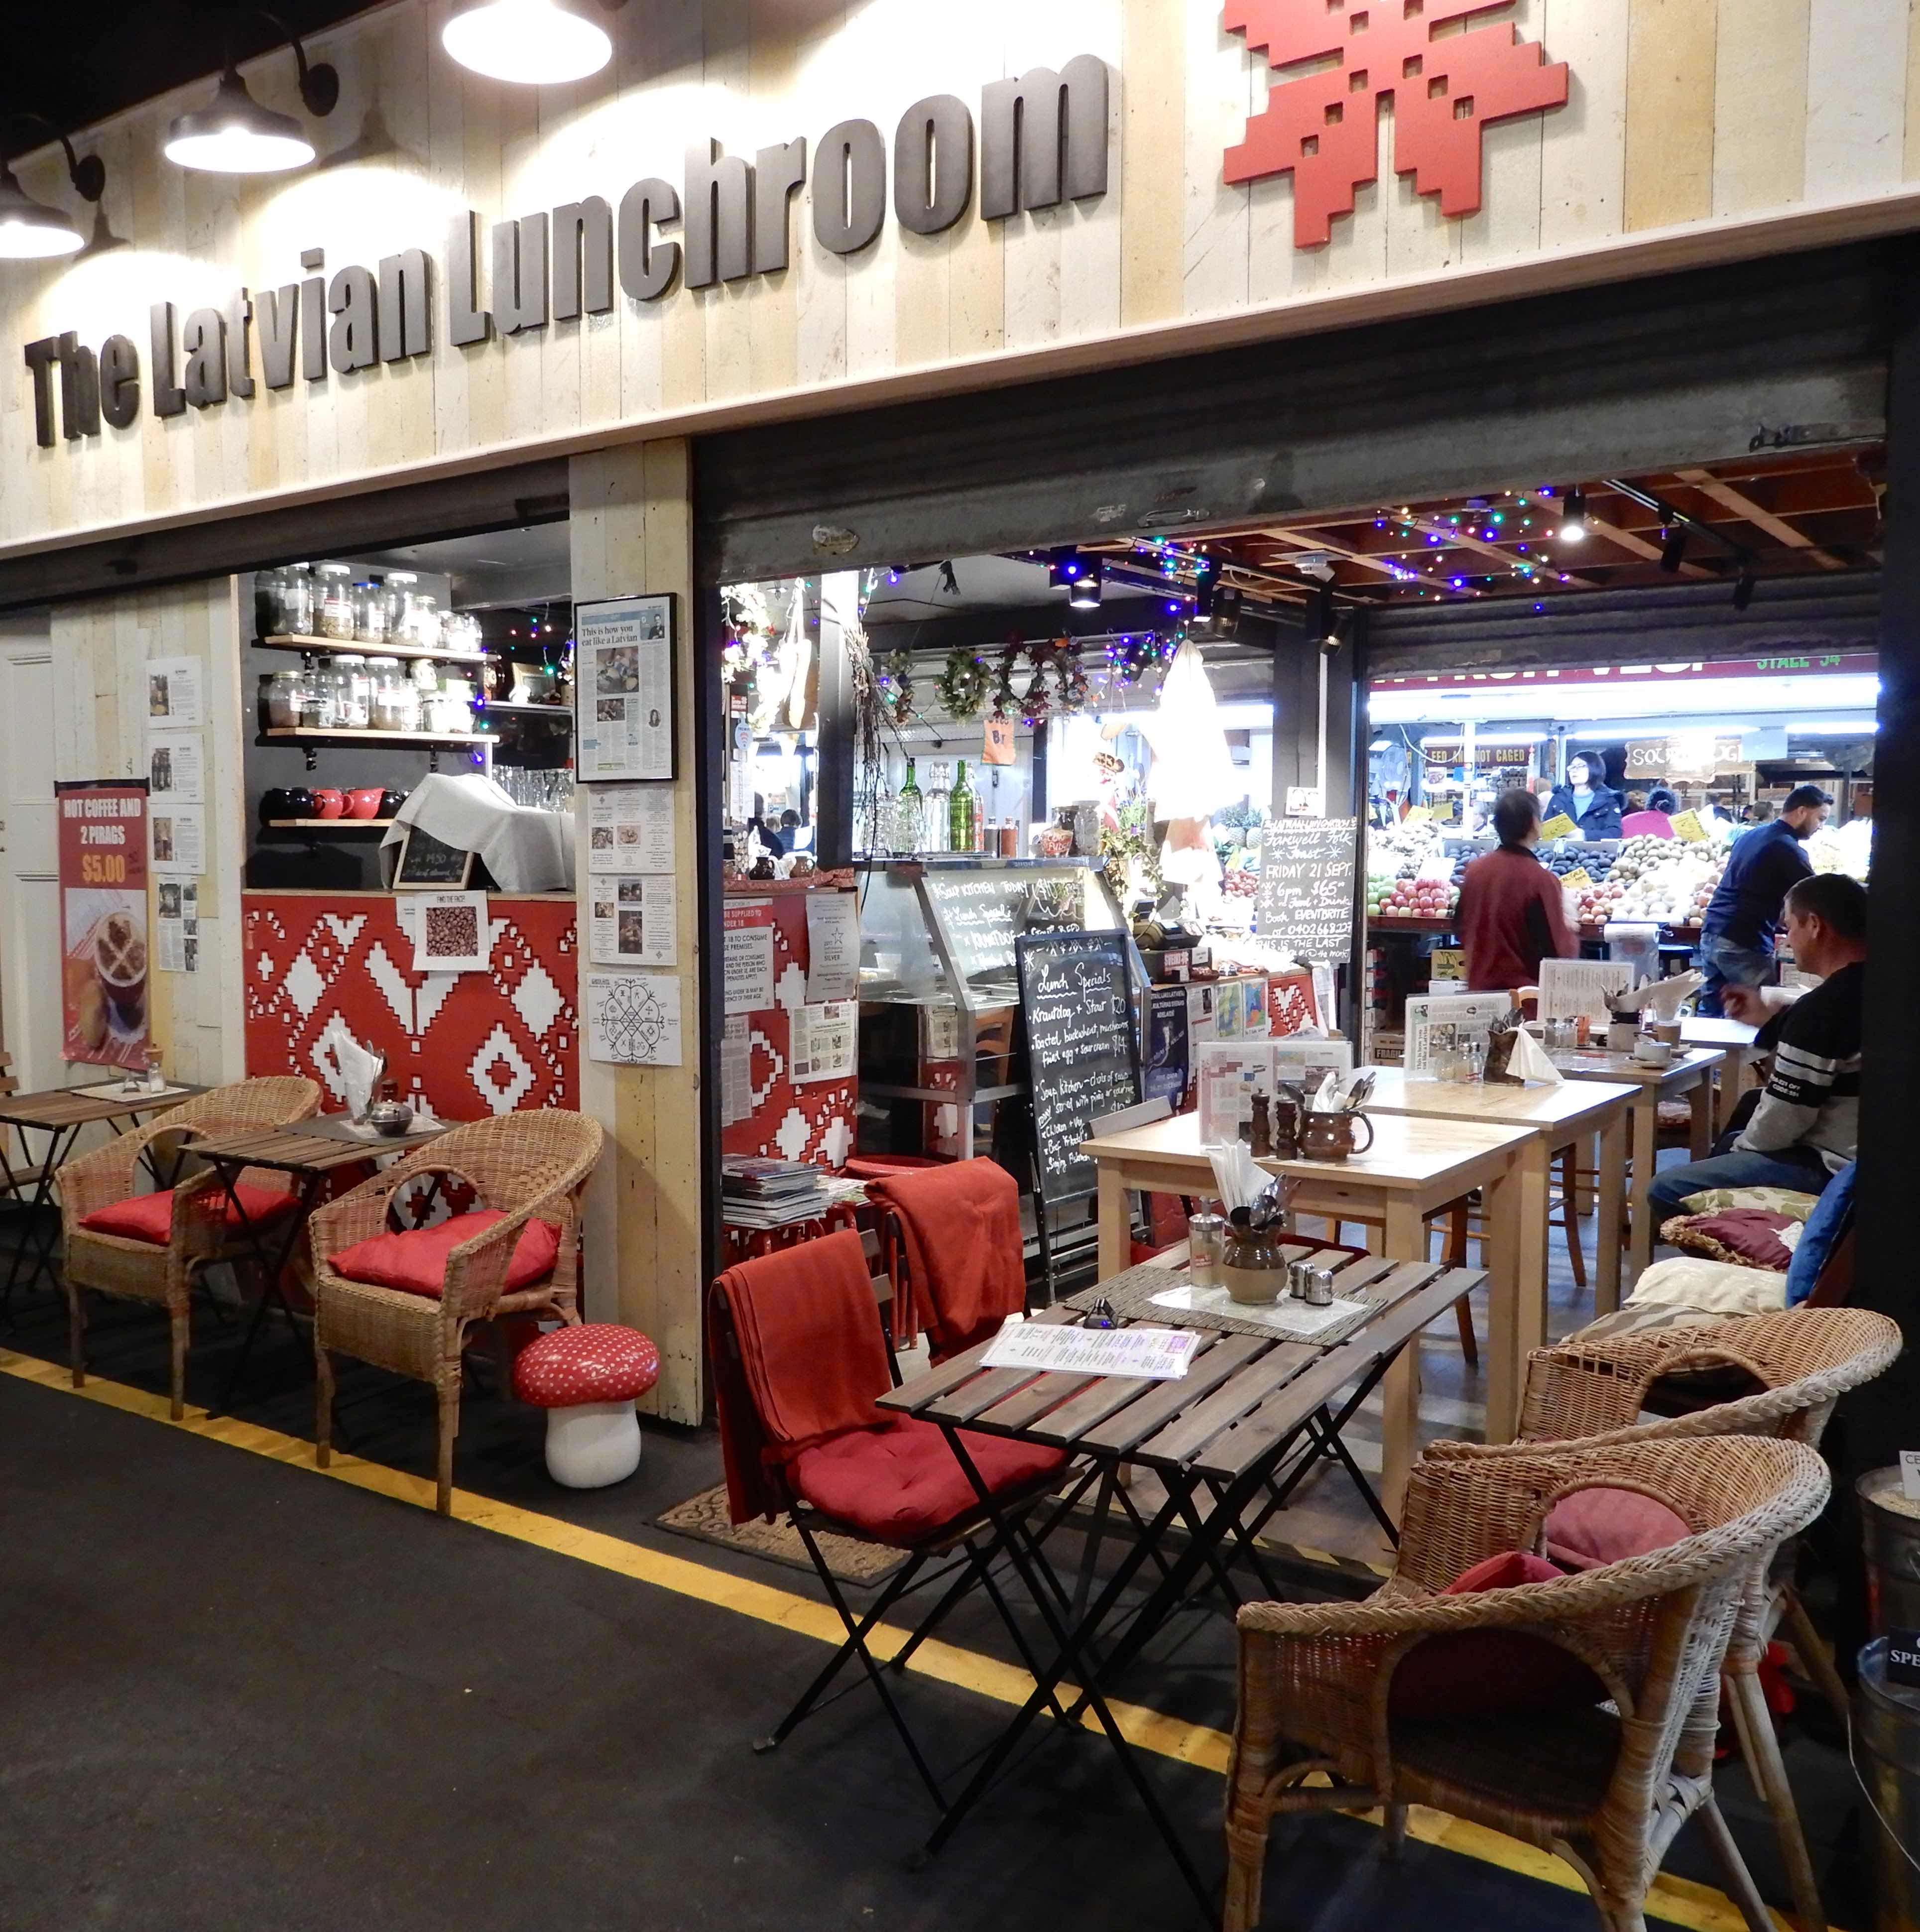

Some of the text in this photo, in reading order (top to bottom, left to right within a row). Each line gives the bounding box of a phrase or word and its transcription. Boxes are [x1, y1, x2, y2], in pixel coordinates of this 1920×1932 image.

[24, 53, 1108, 447] The Latvian Lunchroom
[582, 626, 597, 636] This
[604, 625, 619, 635] how
[620, 625, 633, 635] you
[593, 636, 606, 646] like
[611, 634, 638, 644] Latvian
[1496, 749, 1525, 762] CAGED
[63, 798, 141, 818] HOT COFFEE AND
[80, 825, 126, 845] 2 PIRAGS
[1264, 830, 1353, 847] Farewell Folk
[82, 853, 125, 883] $5.00
[1265, 861, 1353, 880] FRIDAY 21 SEPT.
[960, 881, 996, 897] KITCHEN
[1000, 879, 1030, 898] TODAY
[1276, 882, 1303, 906] 6pm
[731, 909, 754, 918] SUPPLIED
[1265, 907, 1350, 924] Book EVENTBRITE
[1293, 938, 1314, 948] THE
[1316, 937, 1344, 948] LAST
[1038, 962, 1111, 1003] Lunch Specials
[1032, 1004, 1076, 1029] Krautdog
[1110, 994, 1126, 1015] $20
[1032, 1030, 1062, 1050] Toasted
[1042, 1050, 1061, 1069] fried
[1062, 1049, 1074, 1065] egg
[1039, 1079, 1060, 1106] Soup
[1059, 1075, 1084, 1096] kitchen
[1076, 1093, 1089, 1109] with
[1890, 1649, 1920, 1668] SPE
